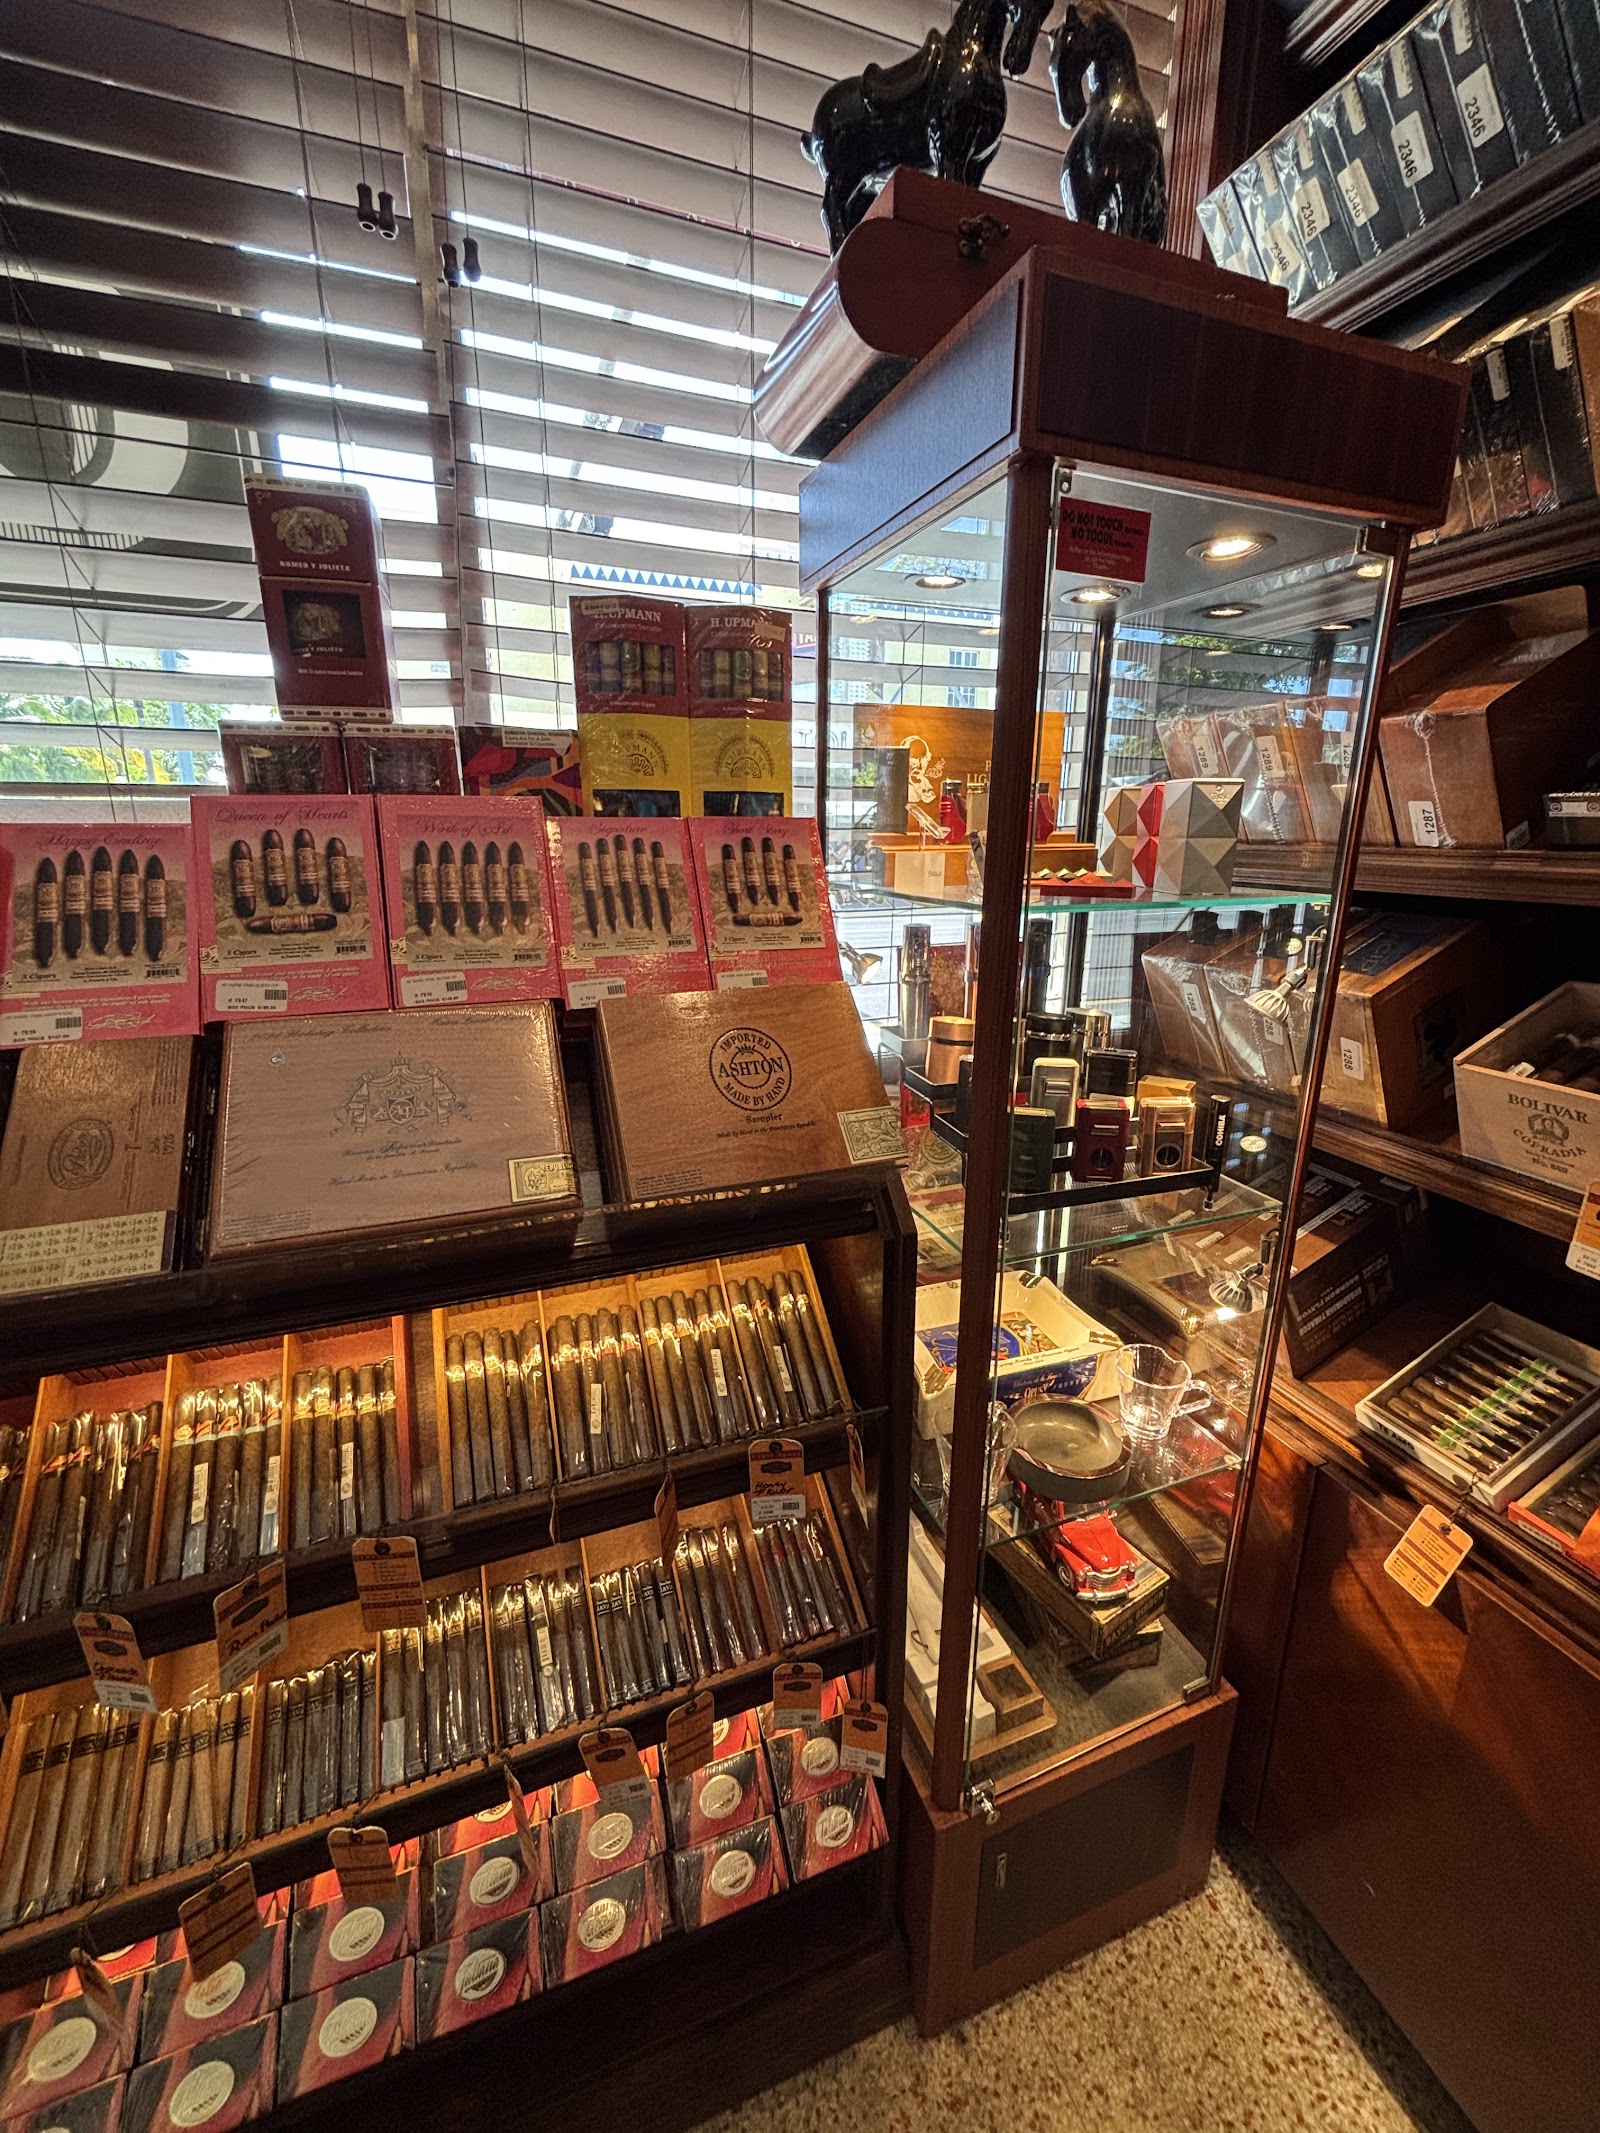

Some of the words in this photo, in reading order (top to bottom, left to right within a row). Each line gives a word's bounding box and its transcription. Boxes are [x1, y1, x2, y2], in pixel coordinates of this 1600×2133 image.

[1464, 97, 1485, 137] 2346
[1398, 140, 1417, 178] 2346
[1345, 187, 1363, 219] 2346
[1301, 201, 1318, 237] 2346
[1270, 242, 1290, 272] 2346
[1062, 509, 1075, 522] DO
[1077, 512, 1095, 526] NOT
[1096, 514, 1124, 531] TOUCH
[1071, 526, 1084, 539] NO
[279, 560, 309, 569] ROMEO
[318, 561, 350, 571] JULIETA
[608, 609, 662, 623] UPMANN
[711, 617, 723, 627] H.
[1196, 745, 1210, 769] 1289
[1259, 747, 1274, 772] 1289
[214, 807, 267, 823] Queen
[273, 810, 289, 826] of
[293, 805, 349, 821] Hearts
[1422, 808, 1436, 835] 1287
[416, 819, 460, 834] Work
[461, 823, 474, 838] of
[592, 821, 648, 837] Signature
[37, 830, 99, 850] Happy
[233, 949, 257, 957] Cigars
[420, 953, 443, 961] Cigars
[28, 972, 57, 981] Cigars
[1186, 991, 1197, 1012] 1288
[1264, 1019, 1274, 1036] 288
[719, 1033, 771, 1052] IMPORTED
[718, 1057, 784, 1079] ASHTON
[1343, 1047, 1354, 1072] 1288
[723, 1082, 751, 1105] MADE
[753, 1095, 765, 1106] BY
[765, 1076, 786, 1103] HAND
[745, 1113, 783, 1124] Sampler
[1507, 1093, 1591, 1125] BOLIVAR
[768, 1124, 796, 1132] Dominican
[796, 1120, 817, 1129] Republic
[1215, 1114, 1227, 1147] COHIBA
[1513, 1129, 1588, 1158] COFRADIA
[755, 1481, 787, 1489] Honey
